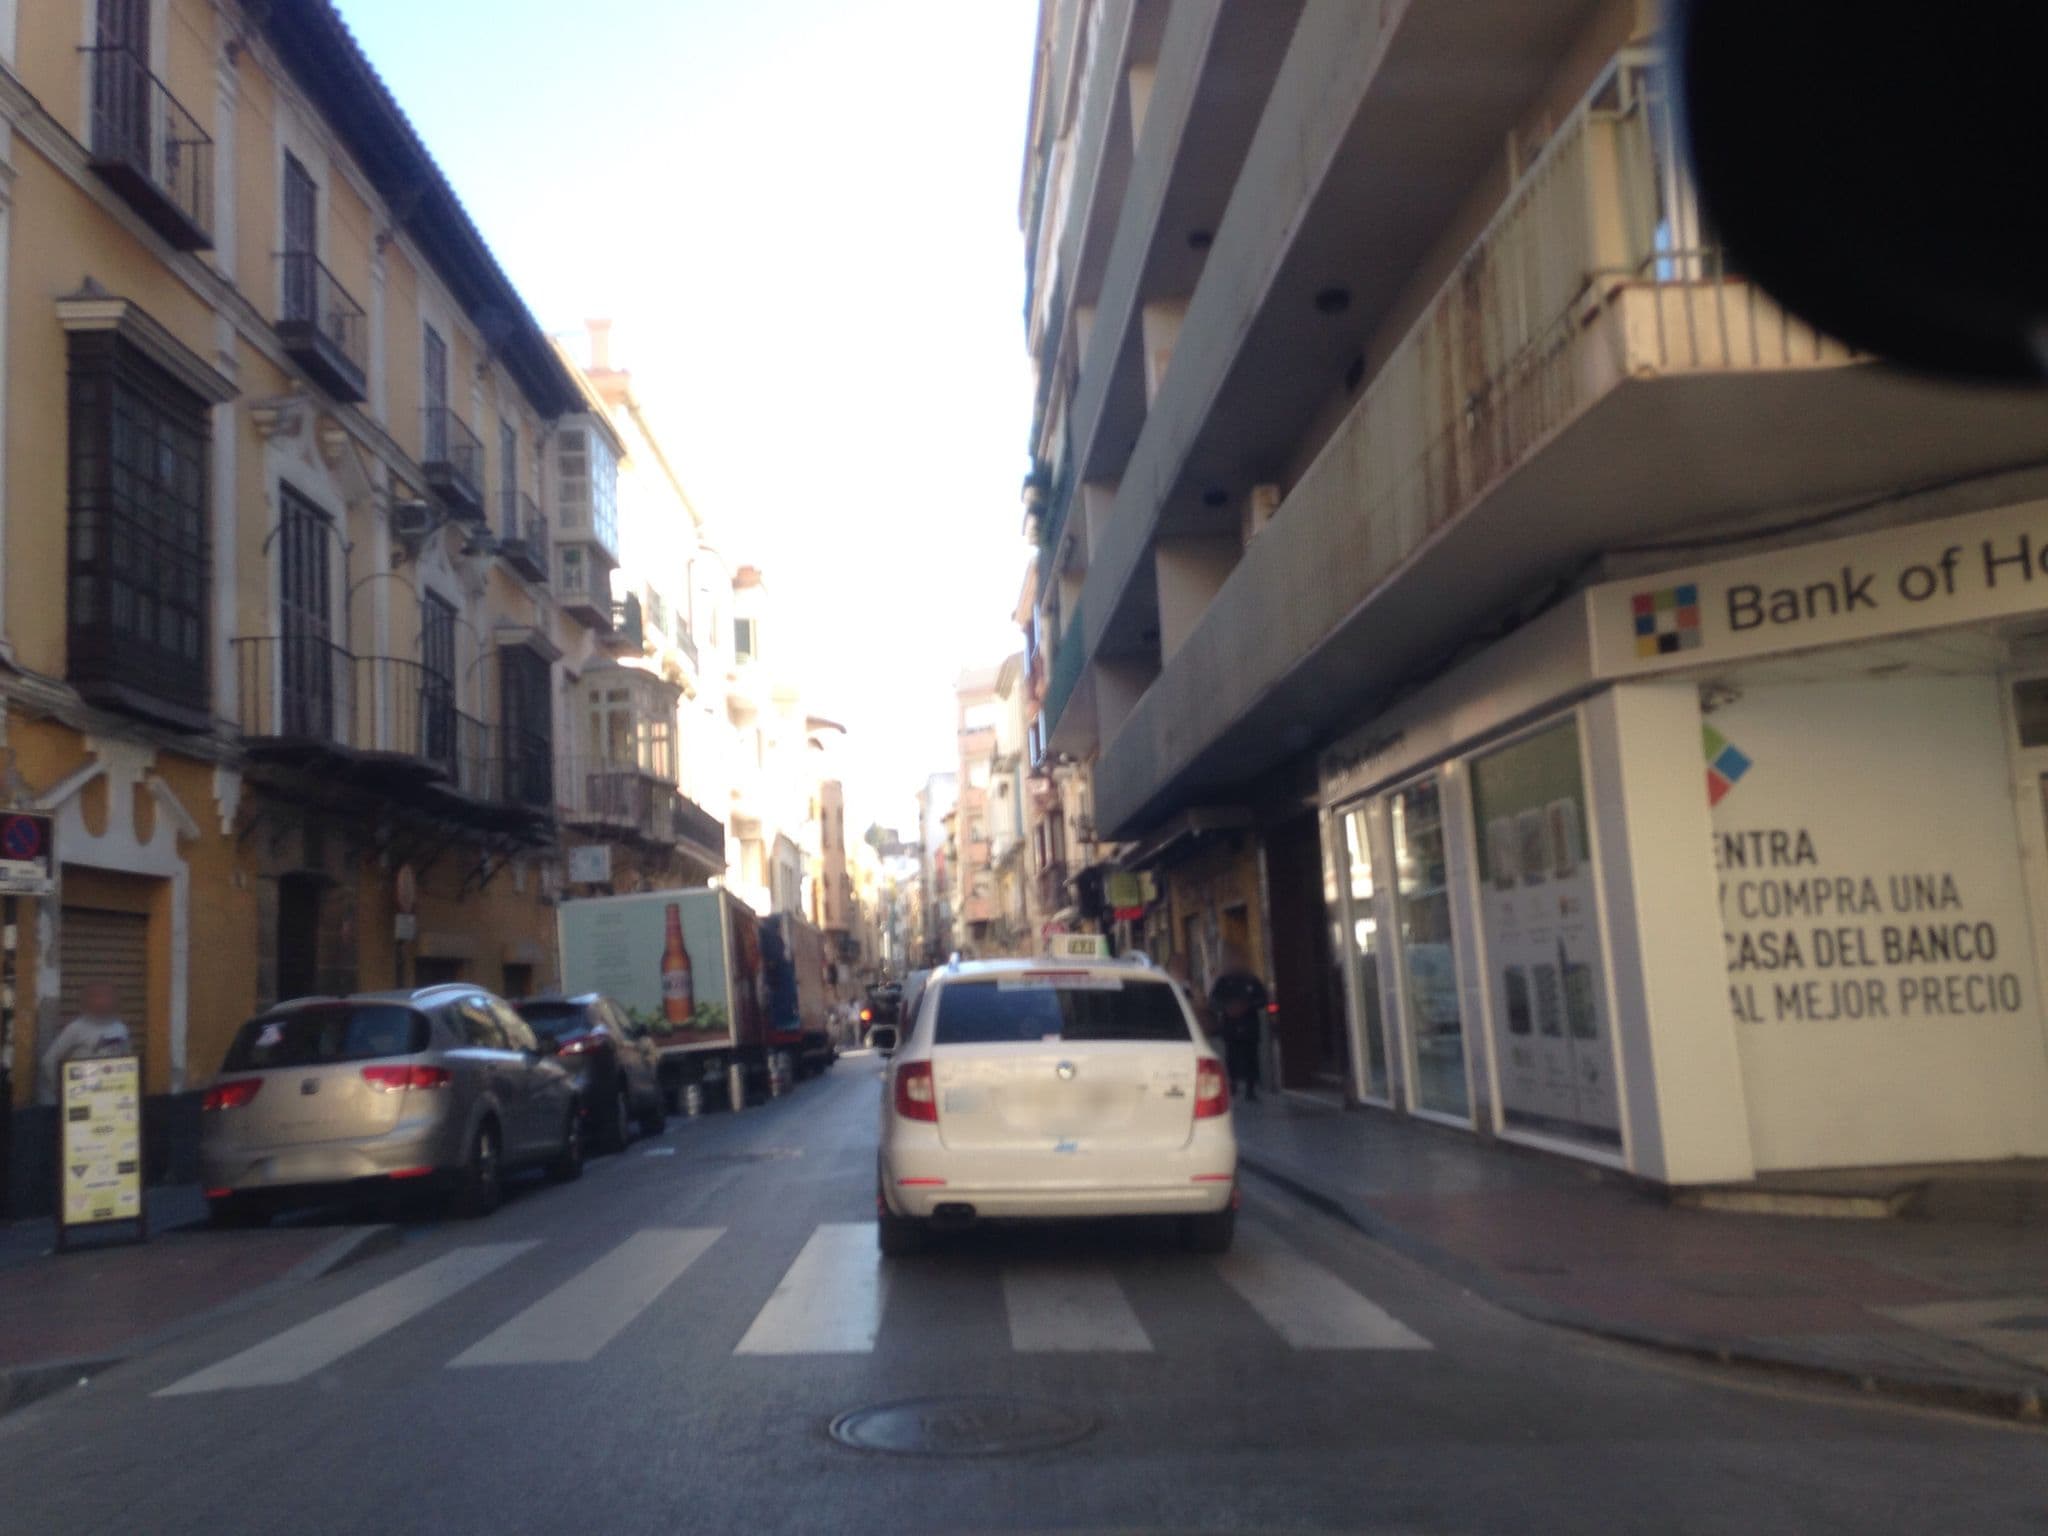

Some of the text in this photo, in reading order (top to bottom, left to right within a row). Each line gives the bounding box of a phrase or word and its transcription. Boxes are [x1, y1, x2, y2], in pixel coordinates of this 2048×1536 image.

[1726, 534, 2048, 632] Bank of H
[1737, 875, 1882, 919] COMPRA
[1889, 872, 1963, 913] UNA
[1812, 927, 1878, 969] DEL
[1882, 921, 1998, 965] BANCO
[1774, 978, 1889, 1023] MEJOR
[1901, 972, 2022, 1017] PRECIO
